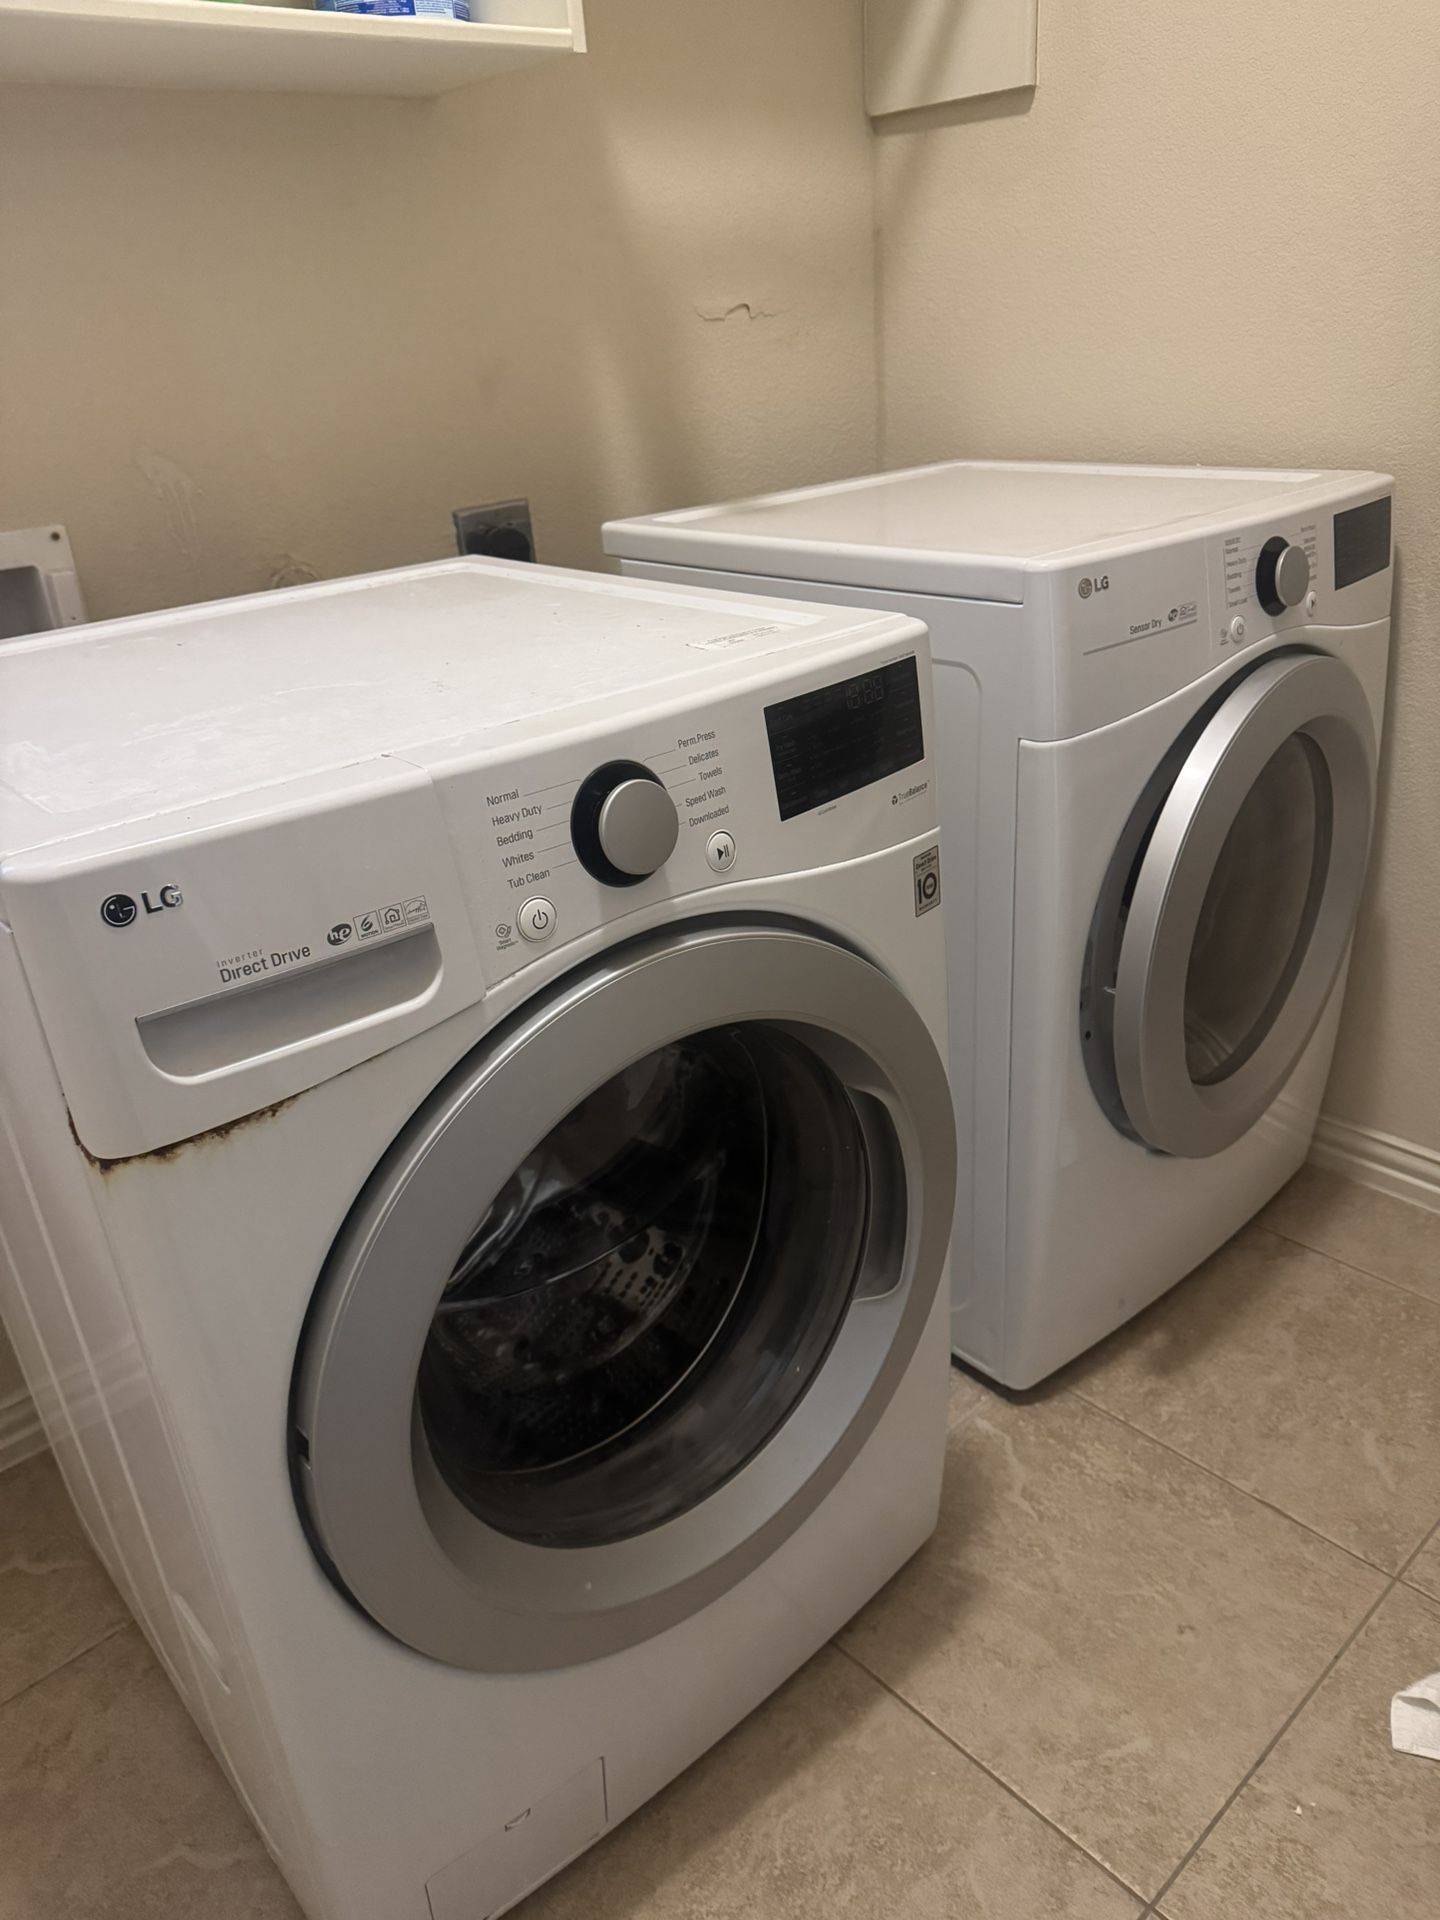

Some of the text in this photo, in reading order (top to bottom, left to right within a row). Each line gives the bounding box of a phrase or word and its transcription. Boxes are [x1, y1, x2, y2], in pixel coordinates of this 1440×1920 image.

[1094, 576, 1109, 592] LG
[1129, 619, 1162, 635] Sensor Dry
[678, 731, 715, 748] Perm Press
[689, 749, 719, 765] Delicates
[699, 767, 722, 781] Towels
[486, 789, 519, 806] Normal
[685, 786, 726, 807] Speed Wash
[491, 805, 543, 827] Heavy Duty
[689, 805, 729, 827] Downloaded
[496, 829, 533, 847] Bedding
[502, 851, 535, 868] Whites
[507, 869, 550, 889] Tub Clean
[141, 884, 183, 914] LG
[216, 949, 263, 968] Inverter
[219, 945, 312, 984] Direct Drive
